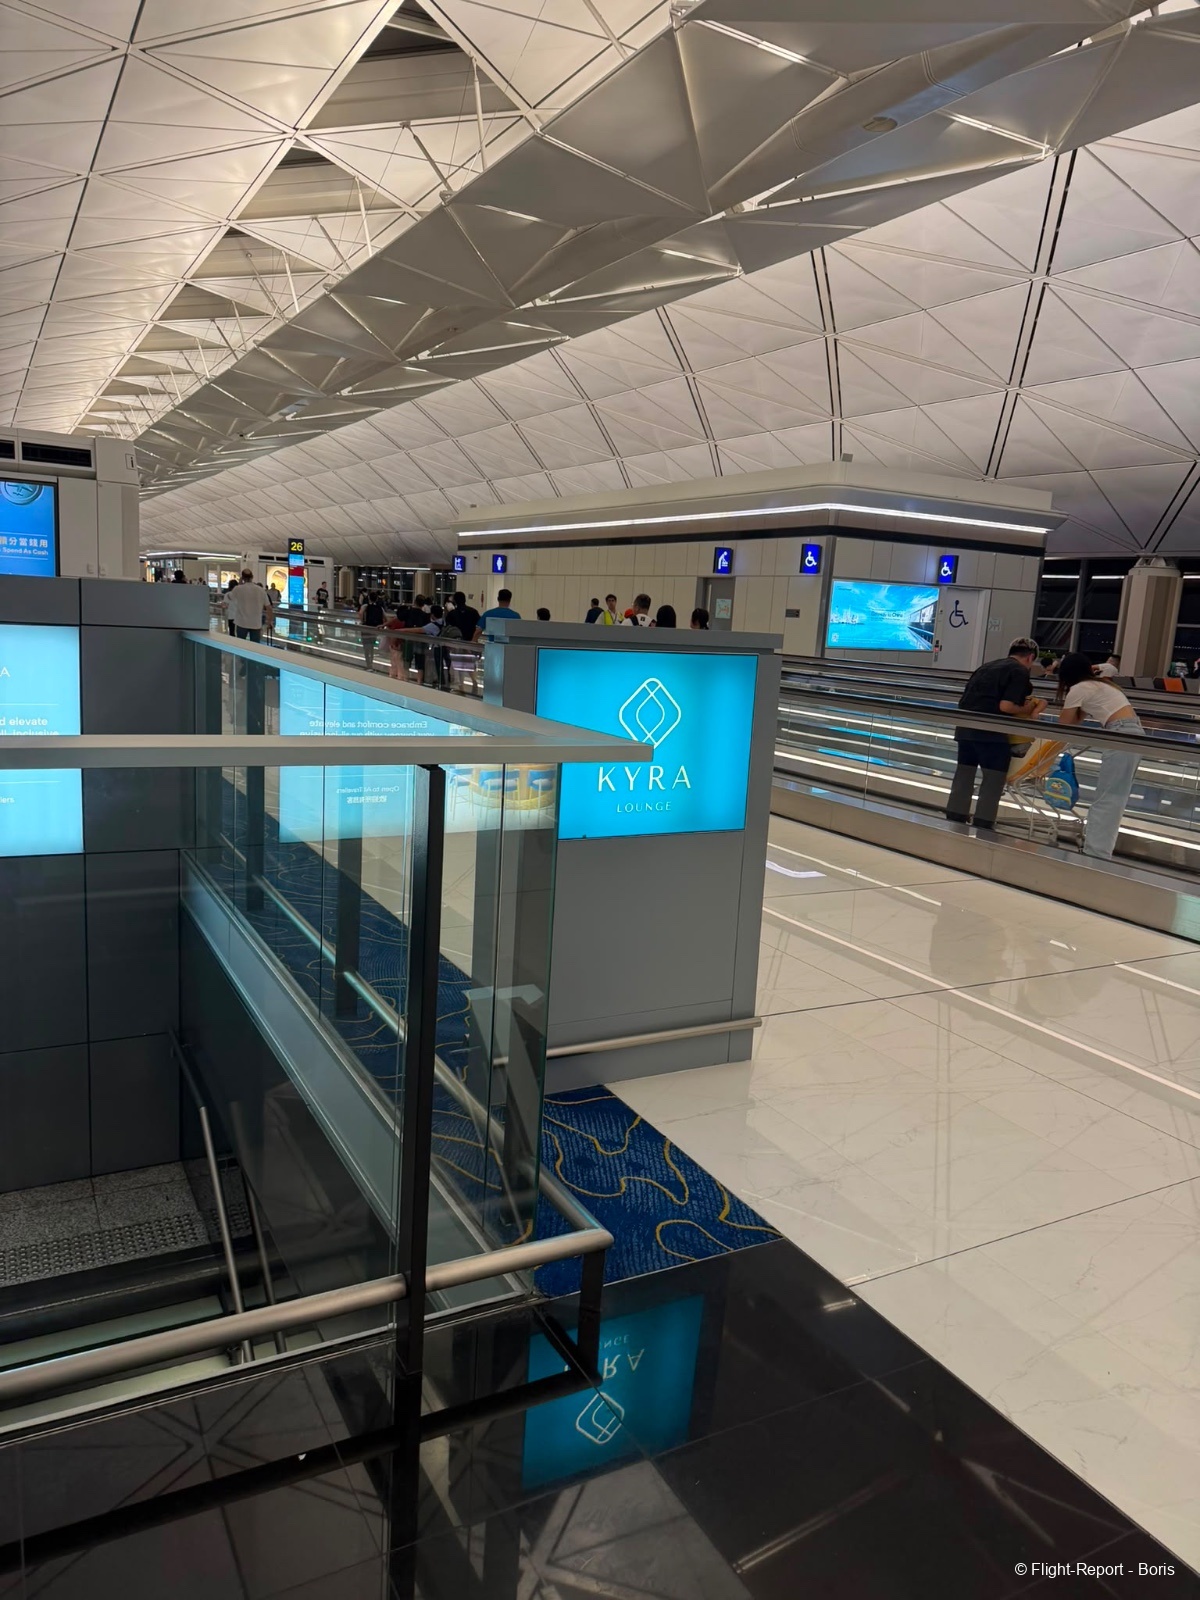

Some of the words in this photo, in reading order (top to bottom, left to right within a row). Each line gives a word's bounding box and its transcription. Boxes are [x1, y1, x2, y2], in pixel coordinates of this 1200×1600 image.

[290, 541, 303, 552] 26
[8, 716, 48, 726] elevate
[598, 765, 691, 792] KYRA
[616, 801, 672, 813] LOUNGE
